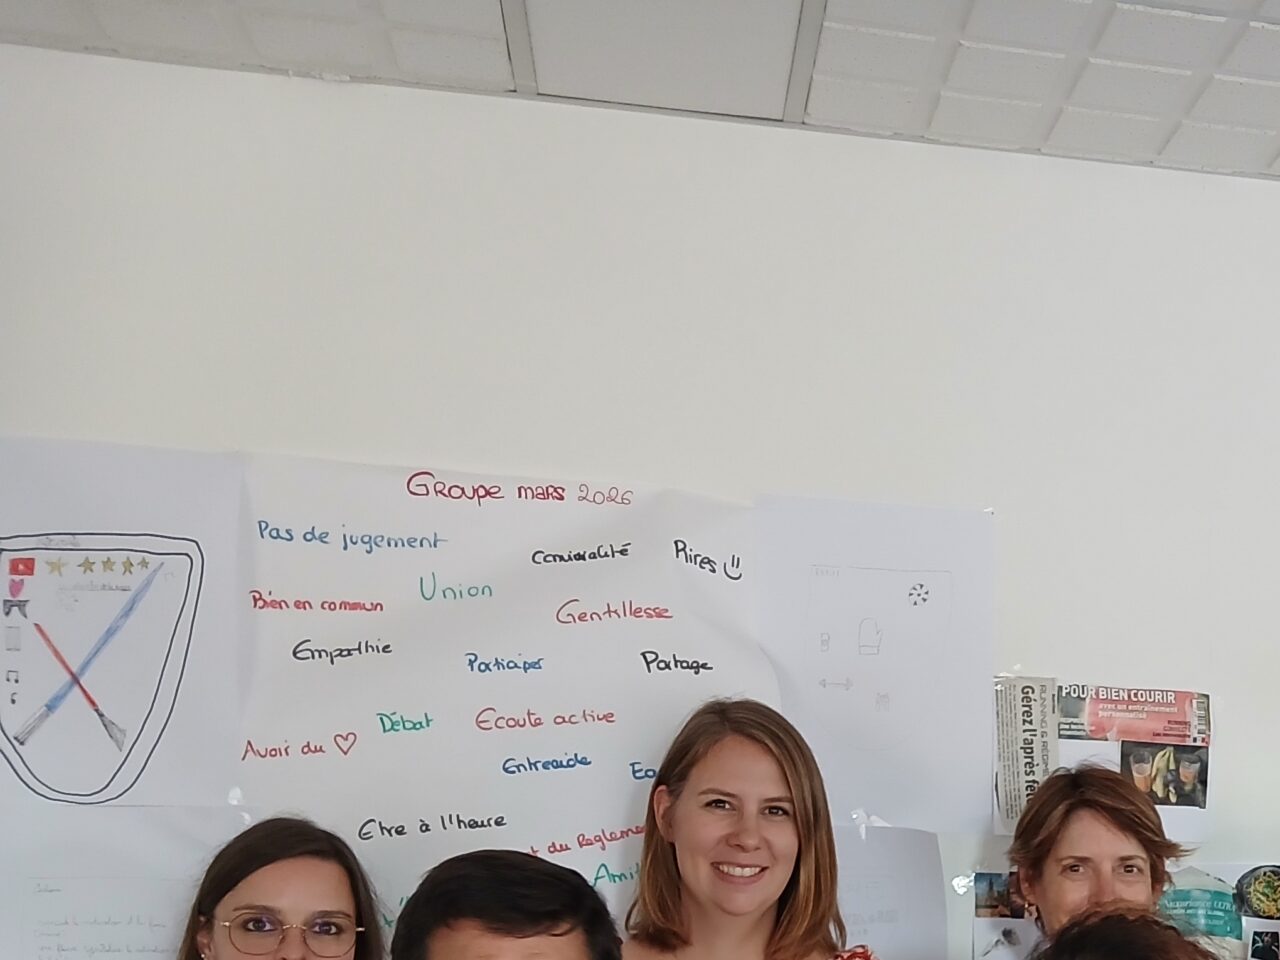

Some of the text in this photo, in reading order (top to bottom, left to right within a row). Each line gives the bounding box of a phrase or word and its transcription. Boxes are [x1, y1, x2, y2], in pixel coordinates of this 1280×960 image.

[578, 483, 633, 506] 2026
[257, 520, 448, 554] Pas de jugement
[673, 539, 718, 574] Rires
[419, 572, 493, 600] Union
[249, 589, 384, 612] Bien en commun
[292, 639, 393, 661] Empathie
[641, 651, 714, 675] Partage
[1021, 685, 1037, 726] Gérez
[1061, 685, 1176, 703] POUR BIEN COURIR
[475, 707, 616, 730] Ecoute active
[241, 740, 326, 762] Avoir du
[1020, 729, 1040, 777] l'après
[358, 813, 507, 840] Etre à l'heure
[548, 842, 571, 853] du
